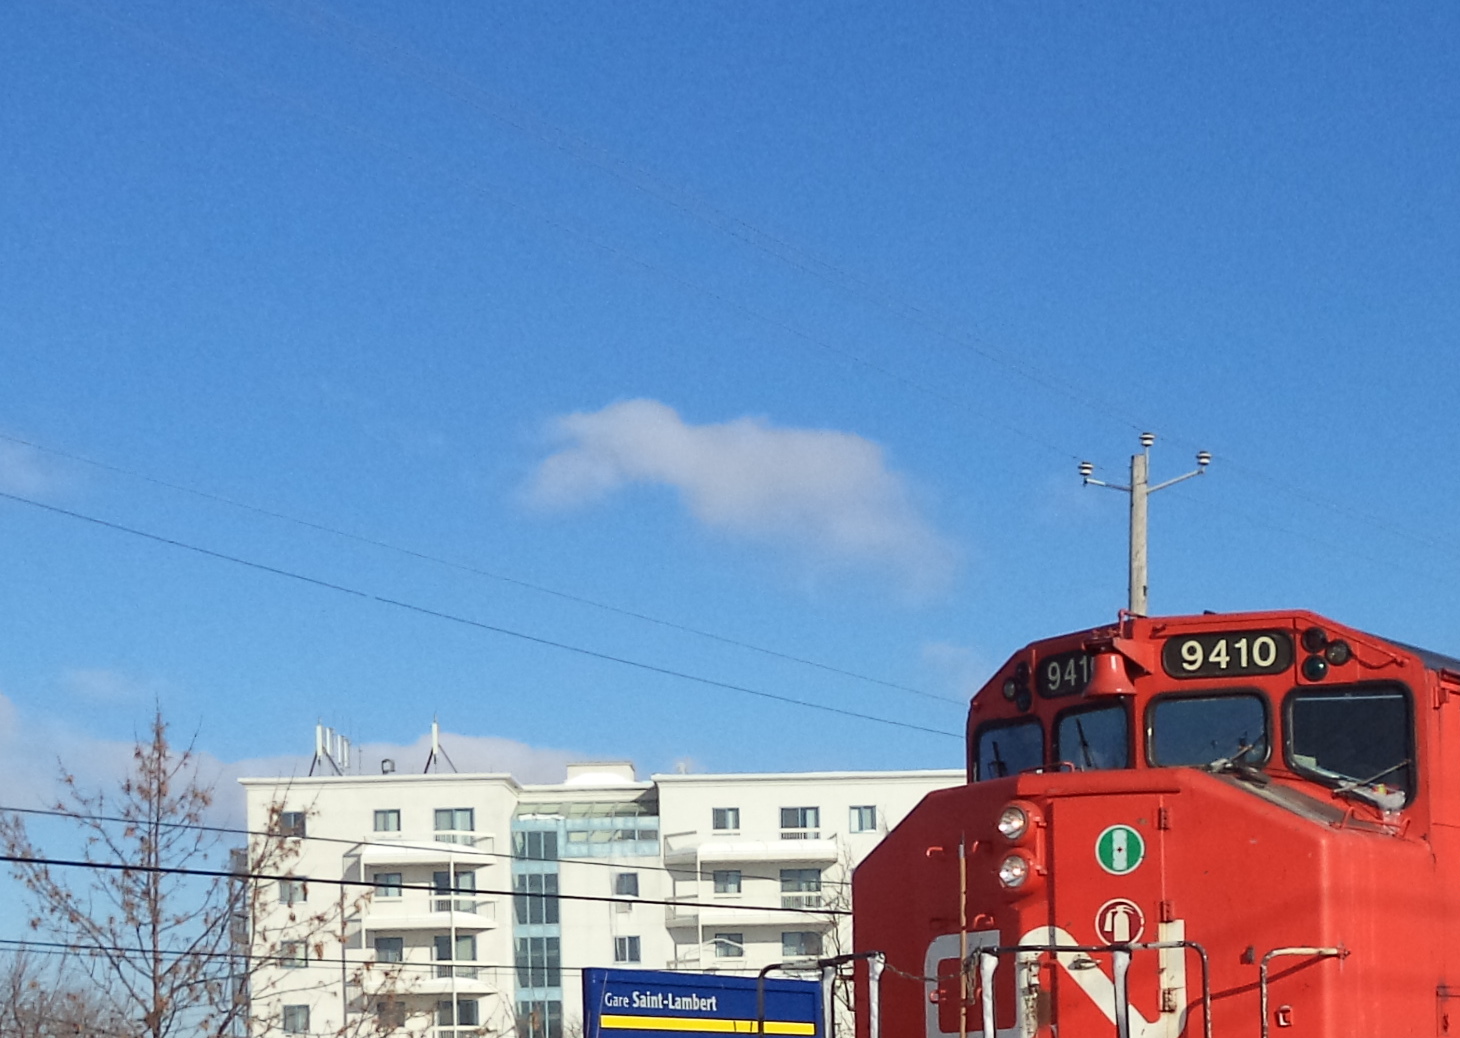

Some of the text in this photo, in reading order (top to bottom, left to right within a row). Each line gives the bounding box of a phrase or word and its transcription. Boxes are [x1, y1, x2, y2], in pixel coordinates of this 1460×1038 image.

[1181, 635, 1278, 671] 9410
[1047, 655, 1095, 690] 941
[604, 991, 717, 1012] Gare Saint-Lambert
